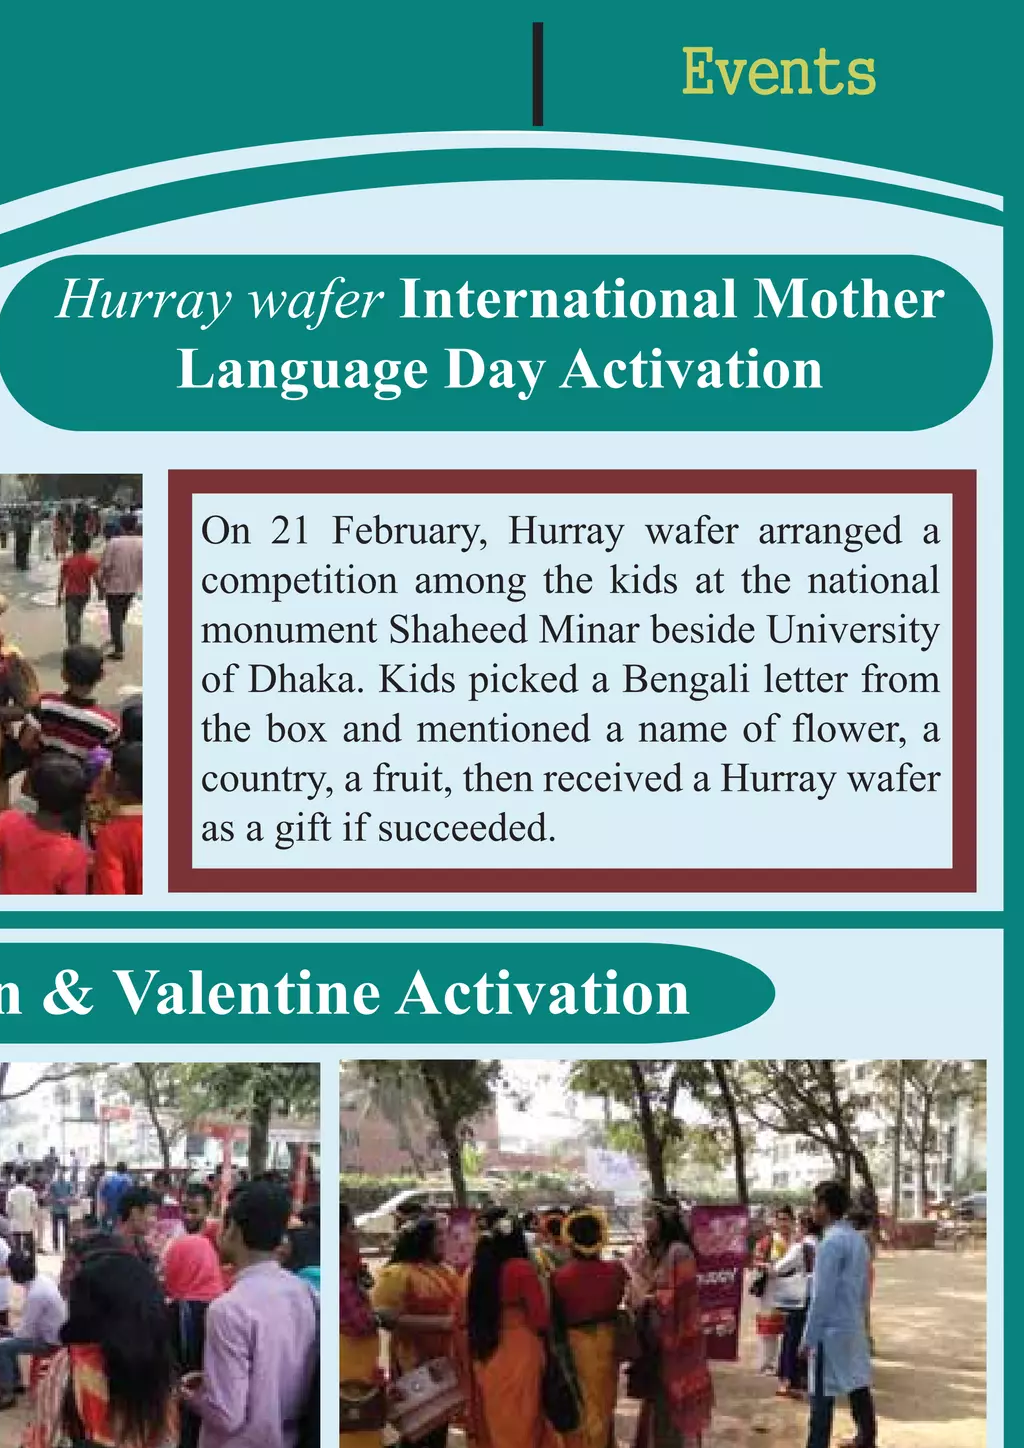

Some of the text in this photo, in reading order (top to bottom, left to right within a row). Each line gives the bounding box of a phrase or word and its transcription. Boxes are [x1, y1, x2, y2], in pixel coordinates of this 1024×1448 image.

[682, 46, 876, 96] Events
[54, 276, 946, 331] Hurray wafer International Mother
[176, 347, 823, 401] Language Day Activation
[201, 514, 941, 553] On 21 February, Hurray wafer arranged a
[201, 563, 940, 603] competition among the kids at the national
[201, 613, 941, 652] monument Shaheed Minar beside University
[201, 712, 941, 749] the box and mentioned a name of flower, a
[201, 811, 555, 850] as a gift if succeeded.
[42, 968, 94, 1016] &
[112, 968, 380, 1016] Valentine
[394, 968, 690, 1016] Activation
